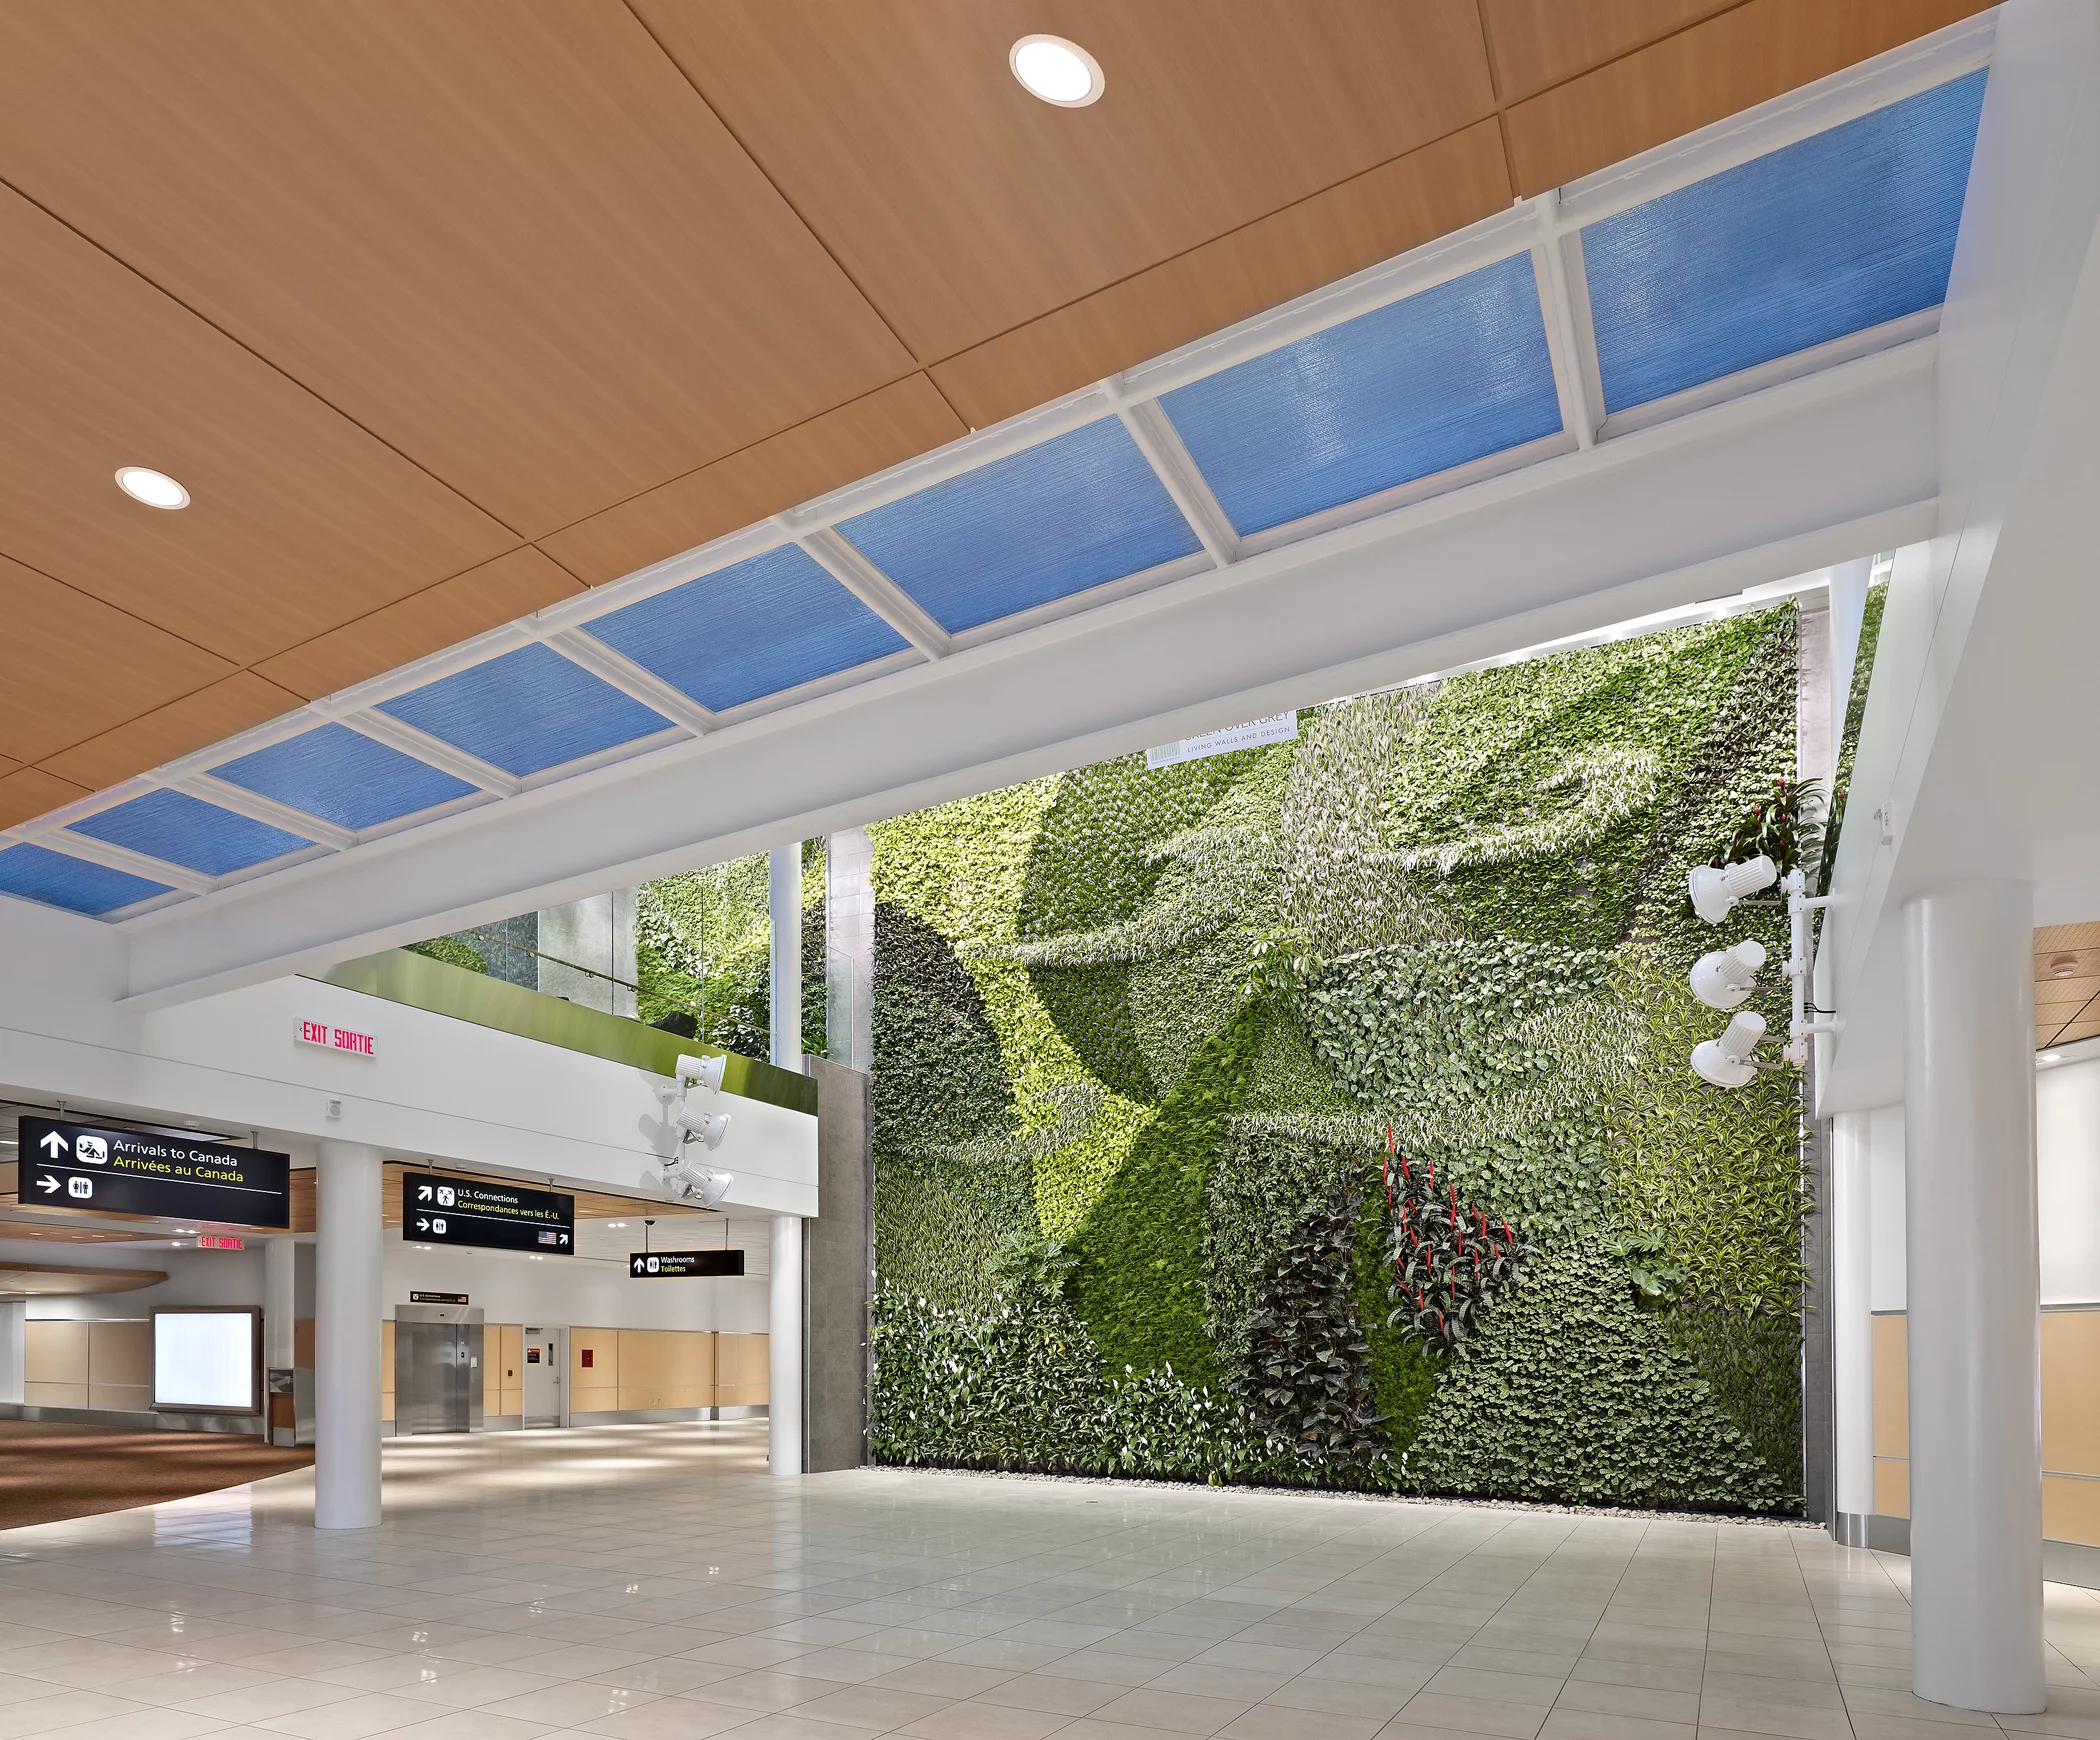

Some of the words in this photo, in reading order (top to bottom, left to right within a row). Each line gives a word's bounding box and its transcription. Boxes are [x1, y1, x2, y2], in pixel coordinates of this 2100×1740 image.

[1187, 742, 1212, 753] LIVING
[1215, 736, 1238, 747] WALLS
[1241, 732, 1256, 740] AND
[1261, 727, 1290, 737] DESIGN
[303, 1021, 327, 1044] EXIT
[334, 1028, 374, 1055] SORTIE
[113, 1139, 167, 1157] Arrivals
[170, 1148, 185, 1159] to
[188, 1150, 237, 1167] Canada
[113, 1156, 171, 1173] Arrivées
[174, 1165, 191, 1175] au
[195, 1166, 244, 1182] Canada
[457, 1188, 472, 1198] U.S.
[474, 1191, 518, 1203] Connections
[458, 1200, 518, 1215] Correspondances
[520, 1208, 533, 1216] vers
[535, 1209, 543, 1218] les
[202, 1236, 215, 1247] EXIT
[218, 1238, 242, 1249] SORTIE
[661, 1256, 695, 1264] Washrooms
